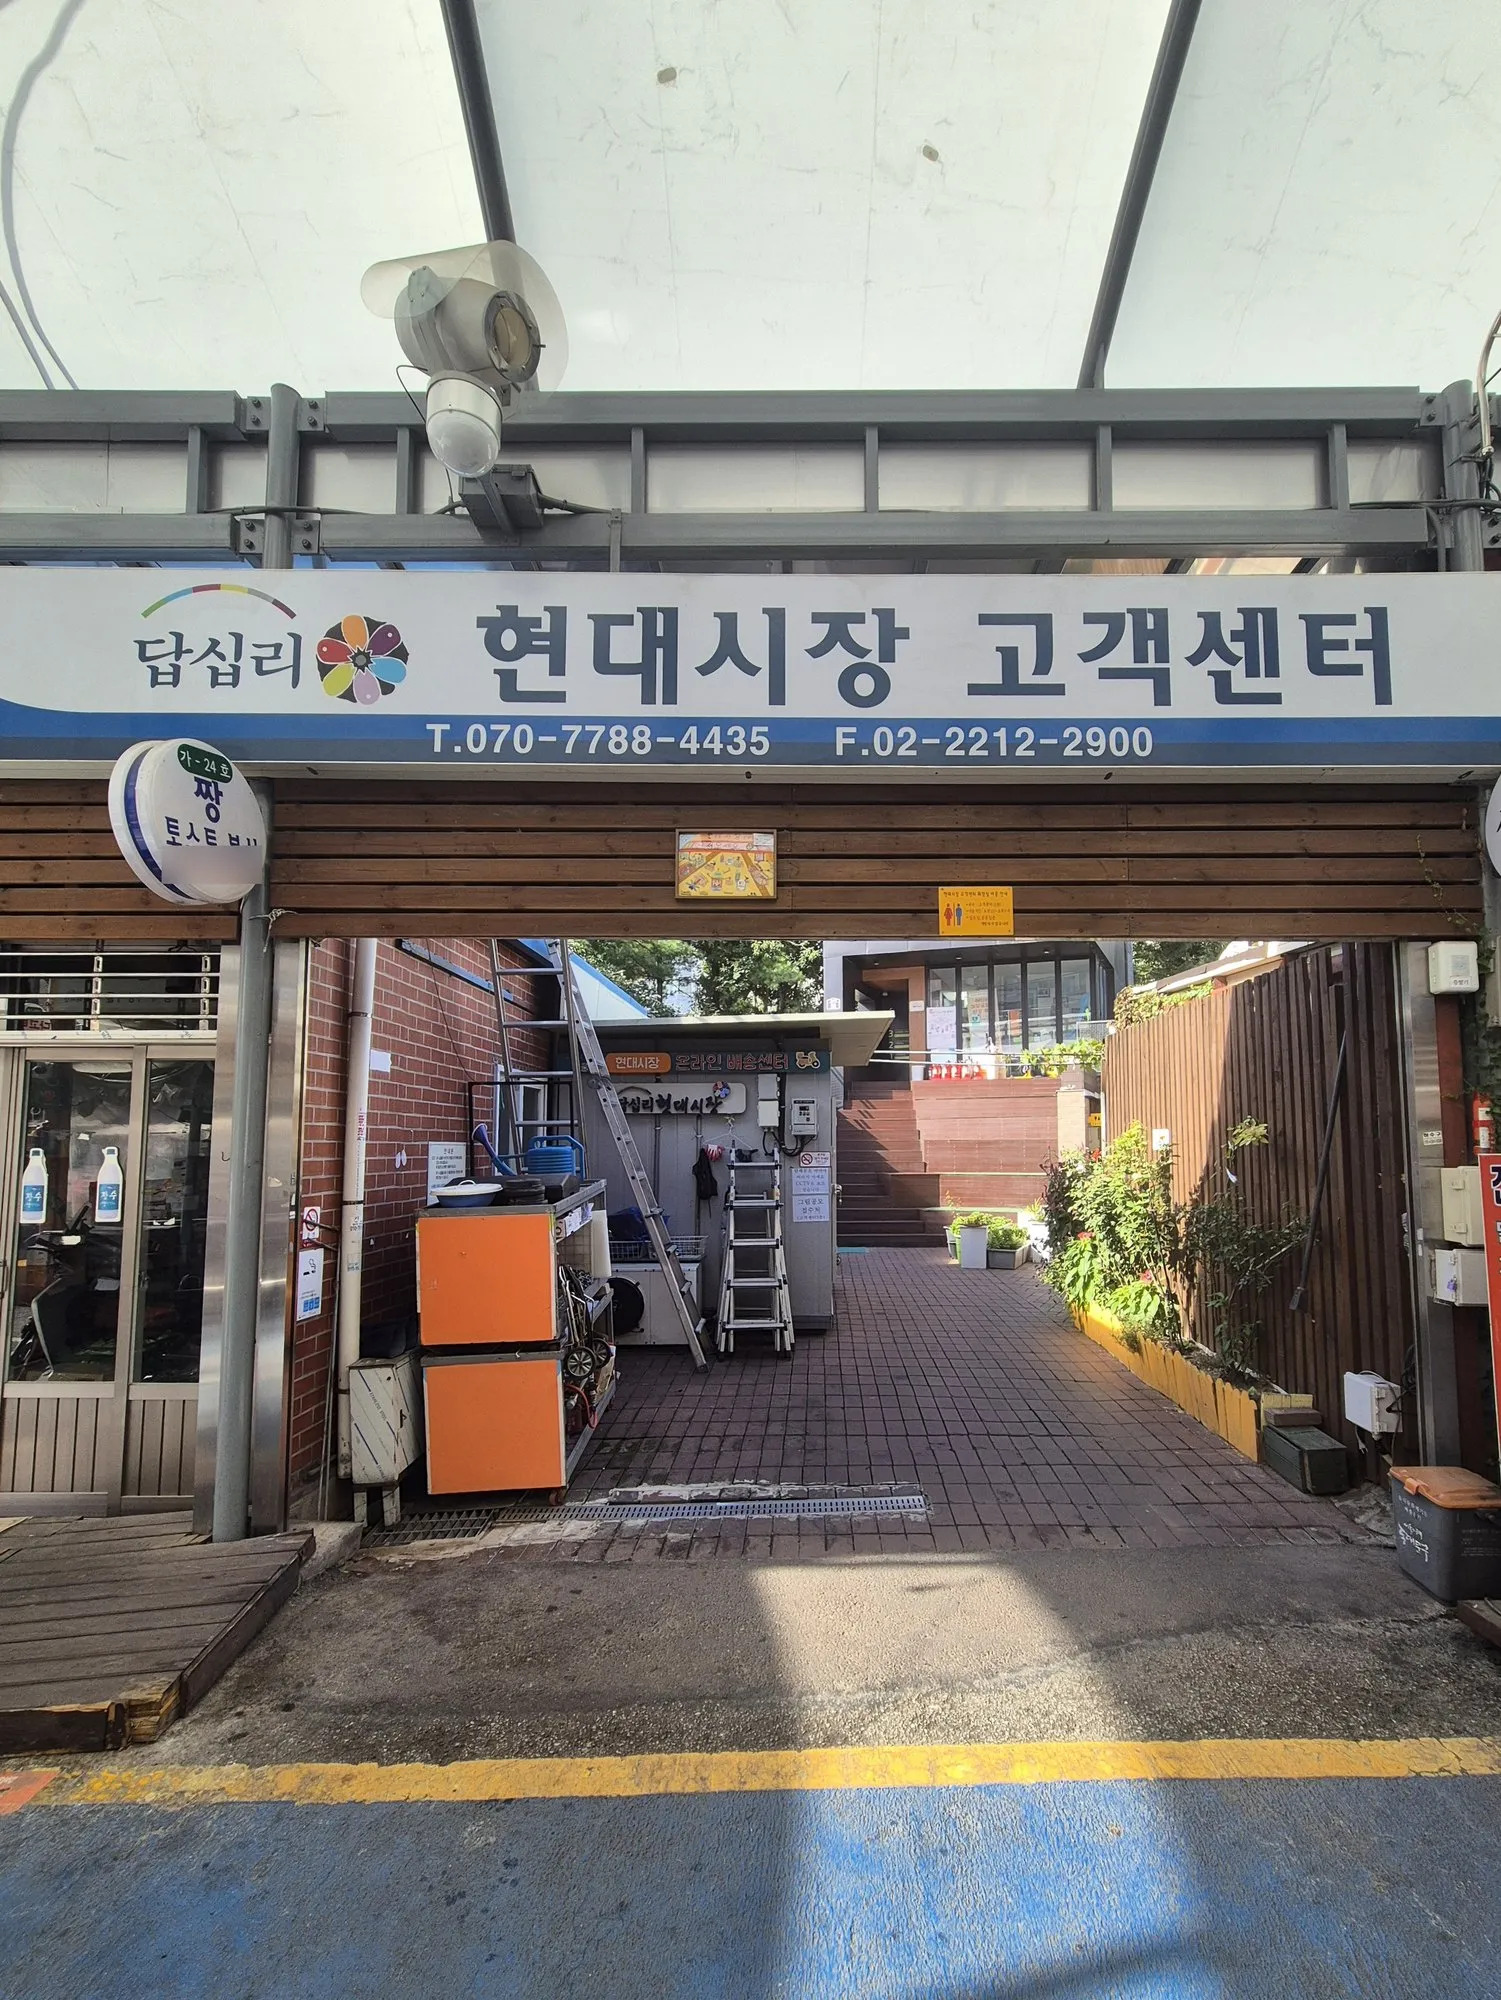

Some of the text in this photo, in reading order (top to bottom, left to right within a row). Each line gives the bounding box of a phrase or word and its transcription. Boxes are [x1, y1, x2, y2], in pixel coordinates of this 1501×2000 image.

[133, 604, 1393, 709] 답십리 현대시장 고객센터
[426, 722, 1153, 758] T.070-7788-4435 F.02-2212-2900
[193, 775, 224, 824] 짱
[615, 1053, 789, 1071] 현대시장 온라인 배송센터
